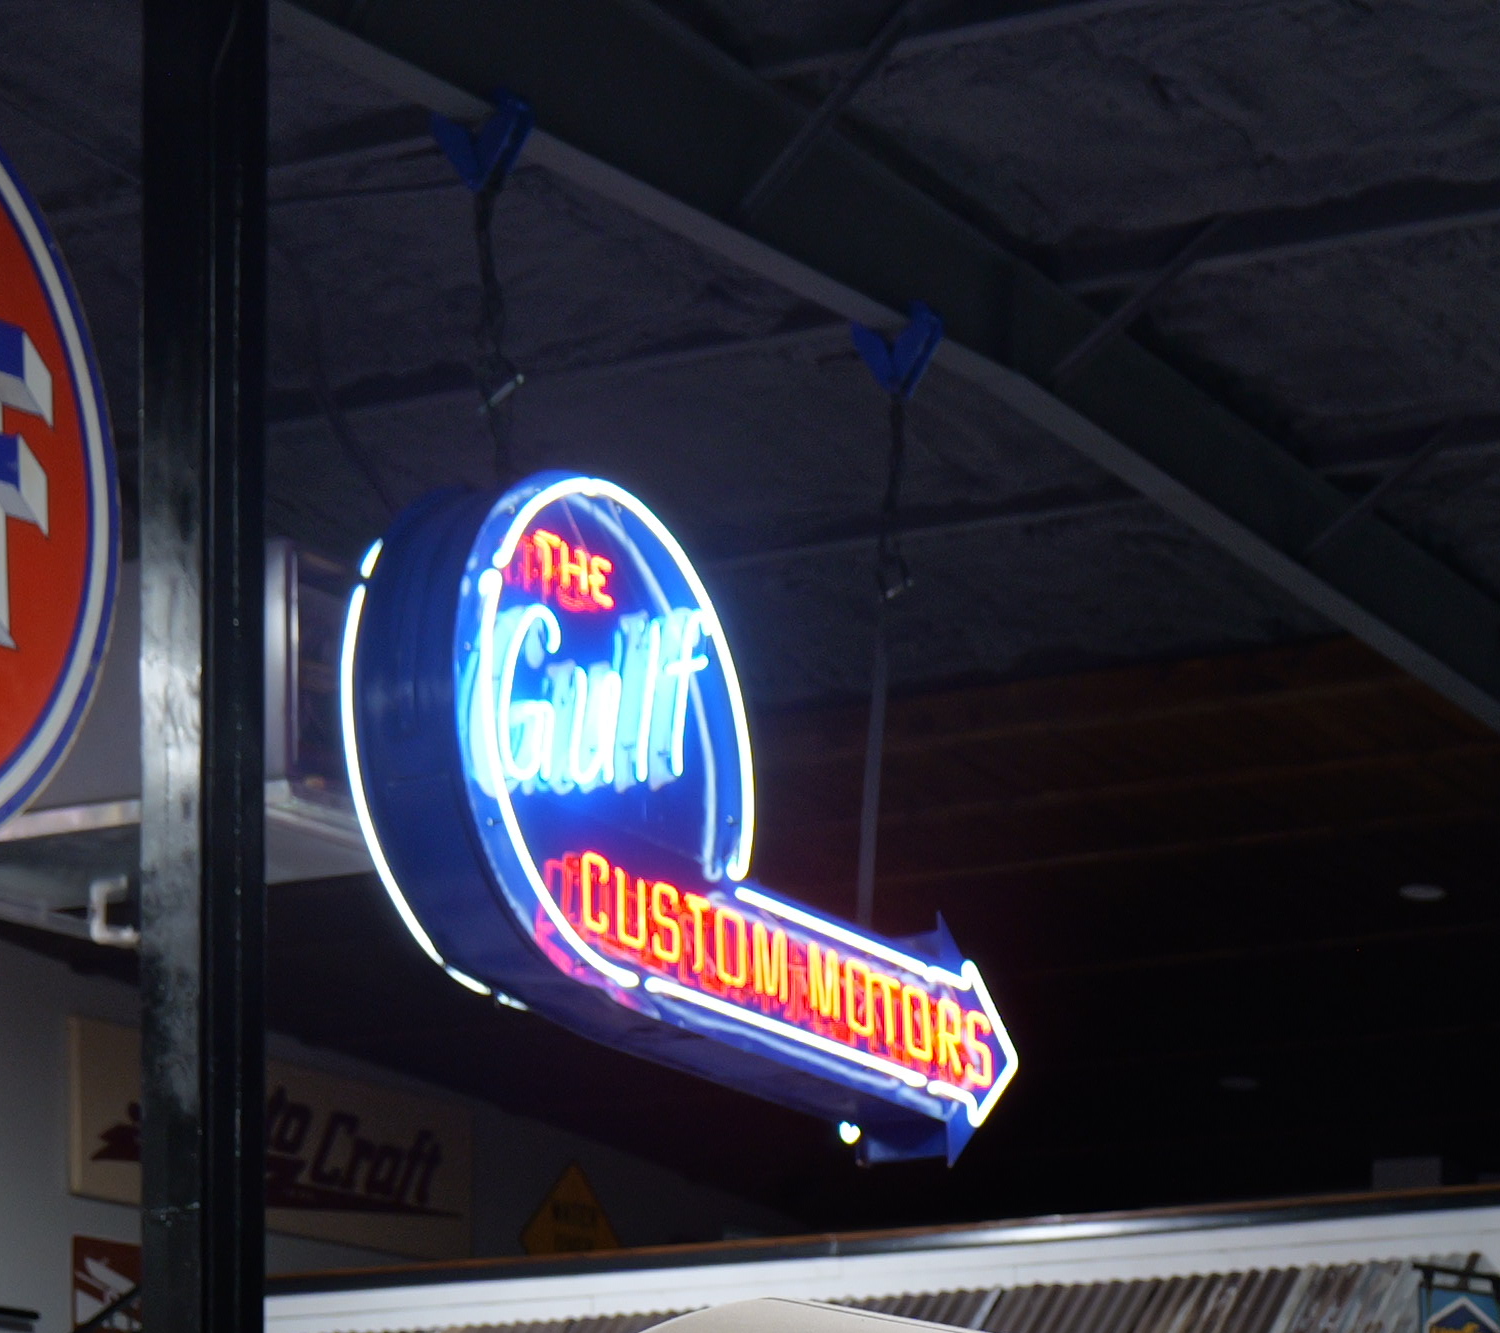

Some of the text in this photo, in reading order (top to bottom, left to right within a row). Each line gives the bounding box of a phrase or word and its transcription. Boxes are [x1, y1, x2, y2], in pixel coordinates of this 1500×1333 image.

[530, 530, 615, 609] THE
[490, 604, 710, 784] Gulf
[580, 851, 995, 1089] CUSTOM MOTORS
[312, 1110, 442, 1203] Craft
